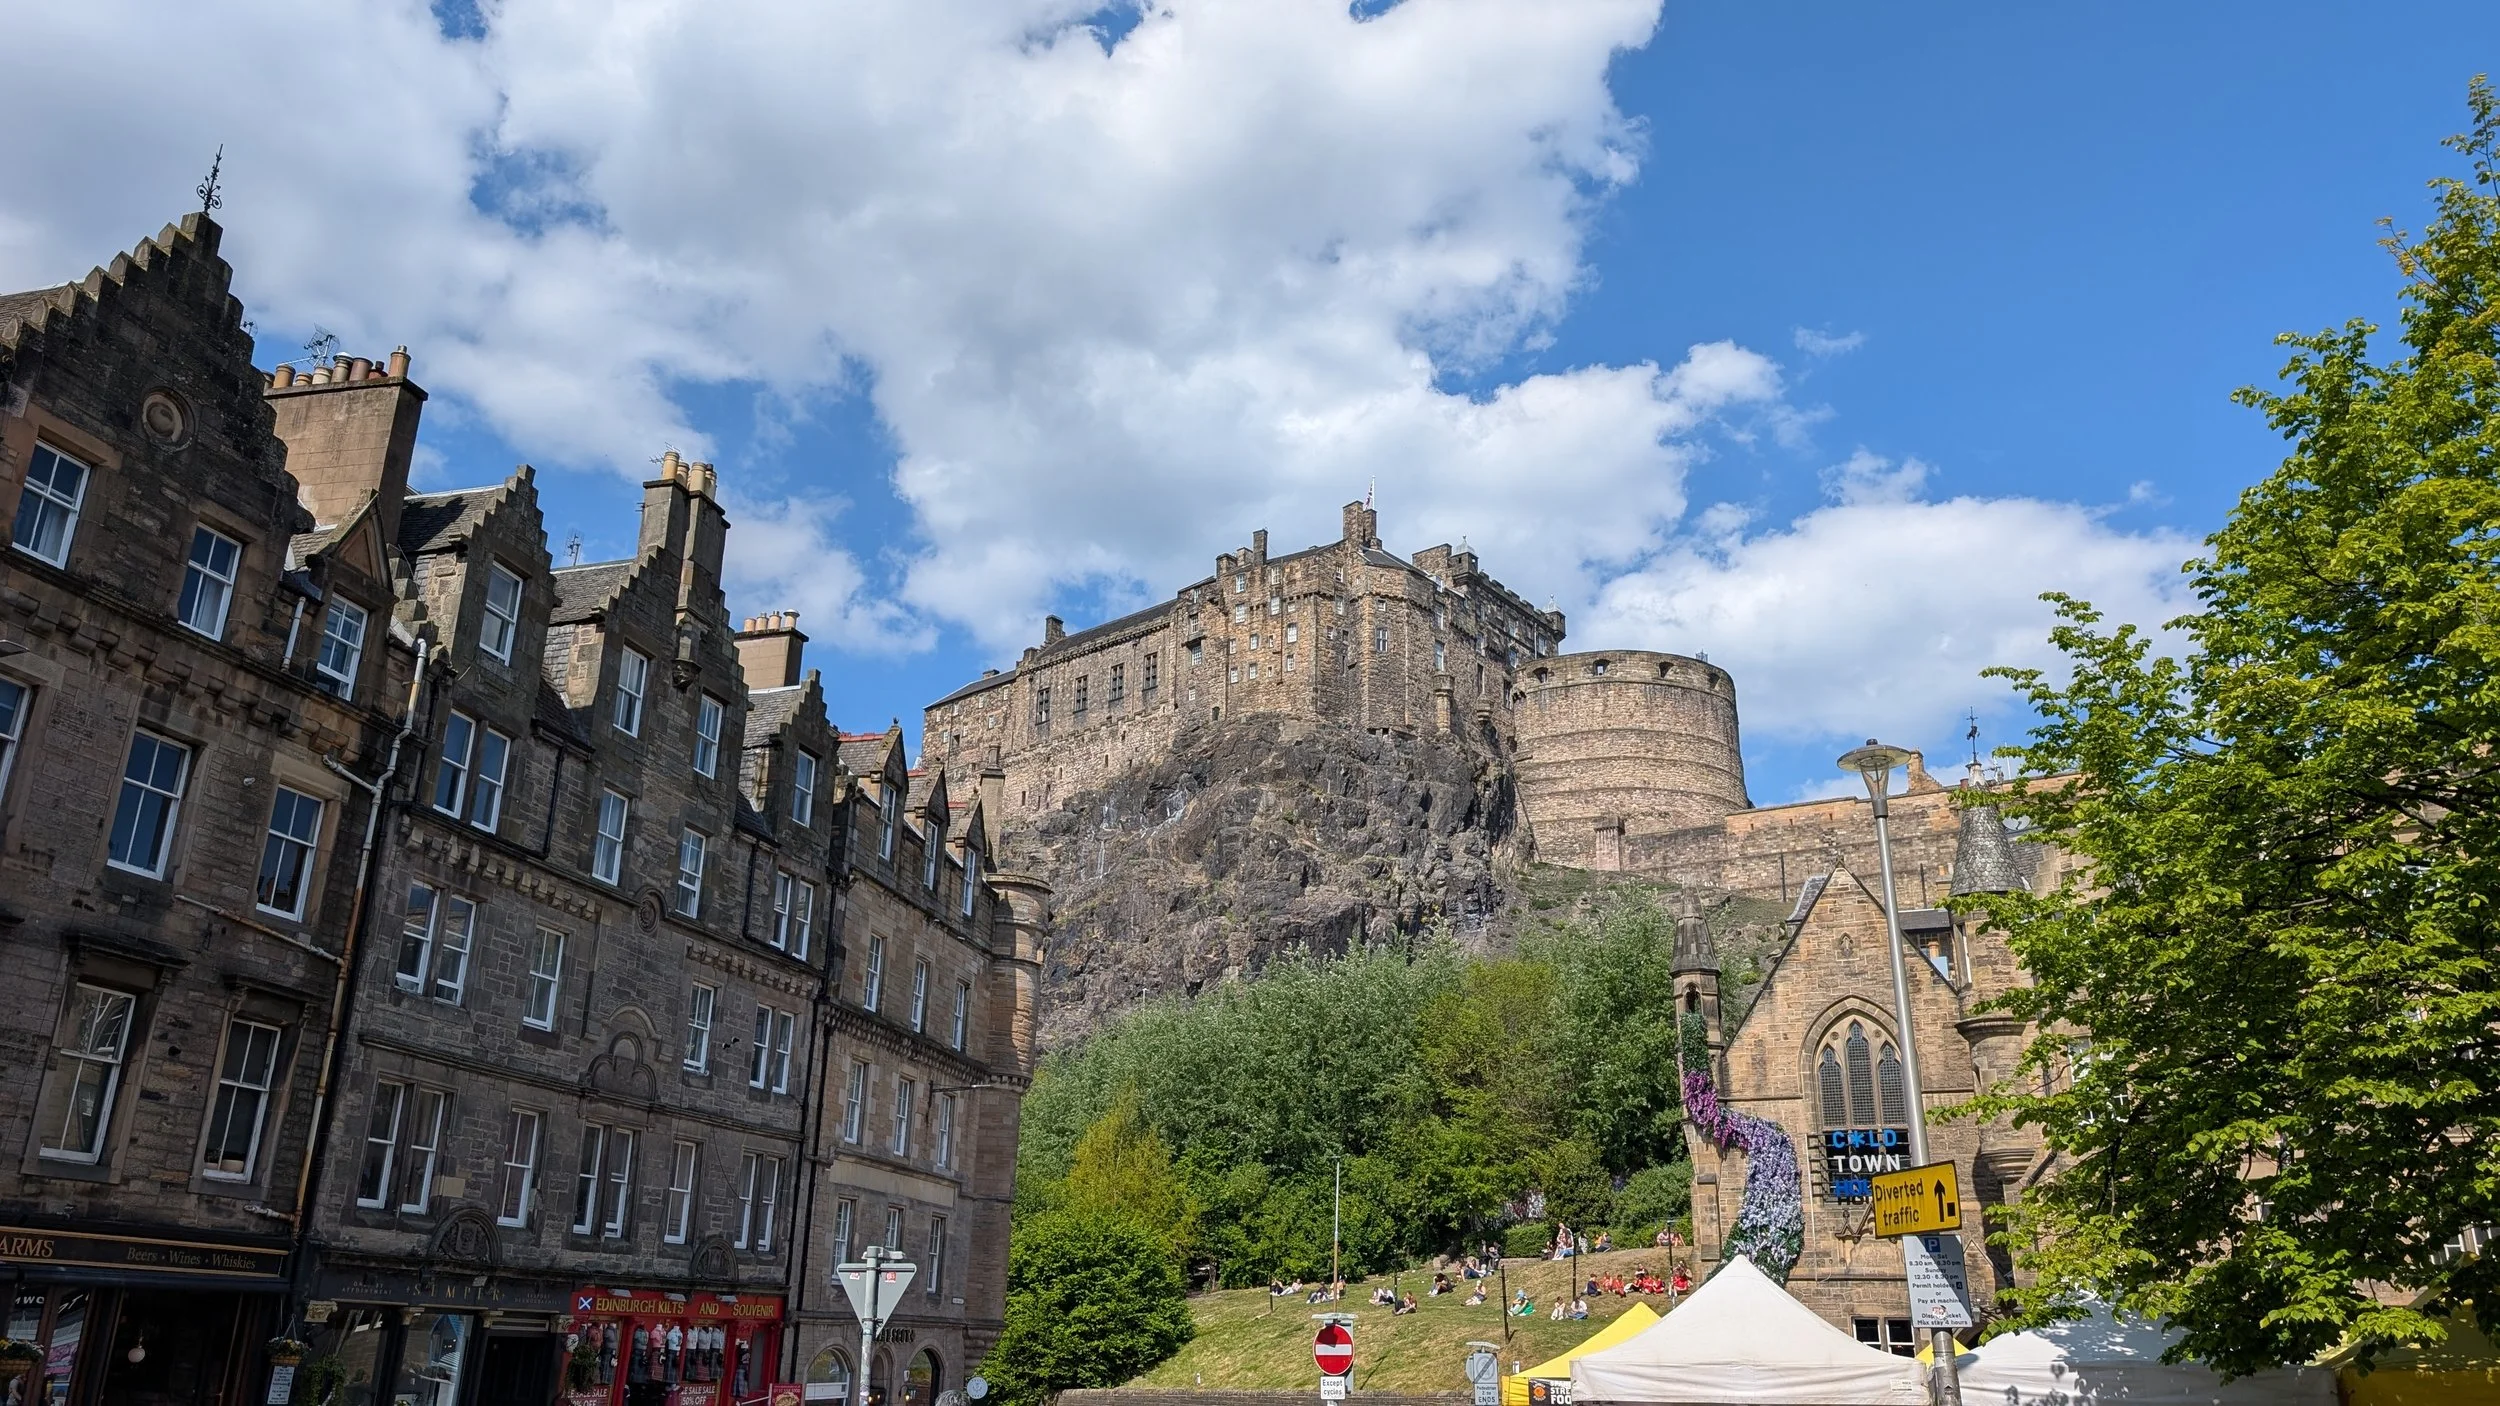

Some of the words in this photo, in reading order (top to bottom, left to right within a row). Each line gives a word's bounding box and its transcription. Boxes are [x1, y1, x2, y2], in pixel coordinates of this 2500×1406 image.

[1833, 1154, 1900, 1172] TOWN
[1875, 1178, 1924, 1201] Diverted
[1883, 1206, 1919, 1226] traffic
[0, 1236, 54, 1257] ARMS
[1928, 1238, 1938, 1251] P
[127, 1247, 158, 1261] Beers
[168, 1250, 201, 1264] Wines
[212, 1253, 256, 1269] Whiskies
[595, 1297, 655, 1314] EDINBURGH
[656, 1300, 684, 1314] KILTS
[699, 1302, 719, 1315] AND
[732, 1304, 774, 1317] SOUVENIR
[688, 1386, 702, 1394] SALE
[702, 1385, 716, 1394] SALE
[1322, 1379, 1343, 1387] Except
[592, 1388, 607, 1397] SALE
[682, 1396, 694, 1405] 50%
[695, 1396, 707, 1405] OFF
